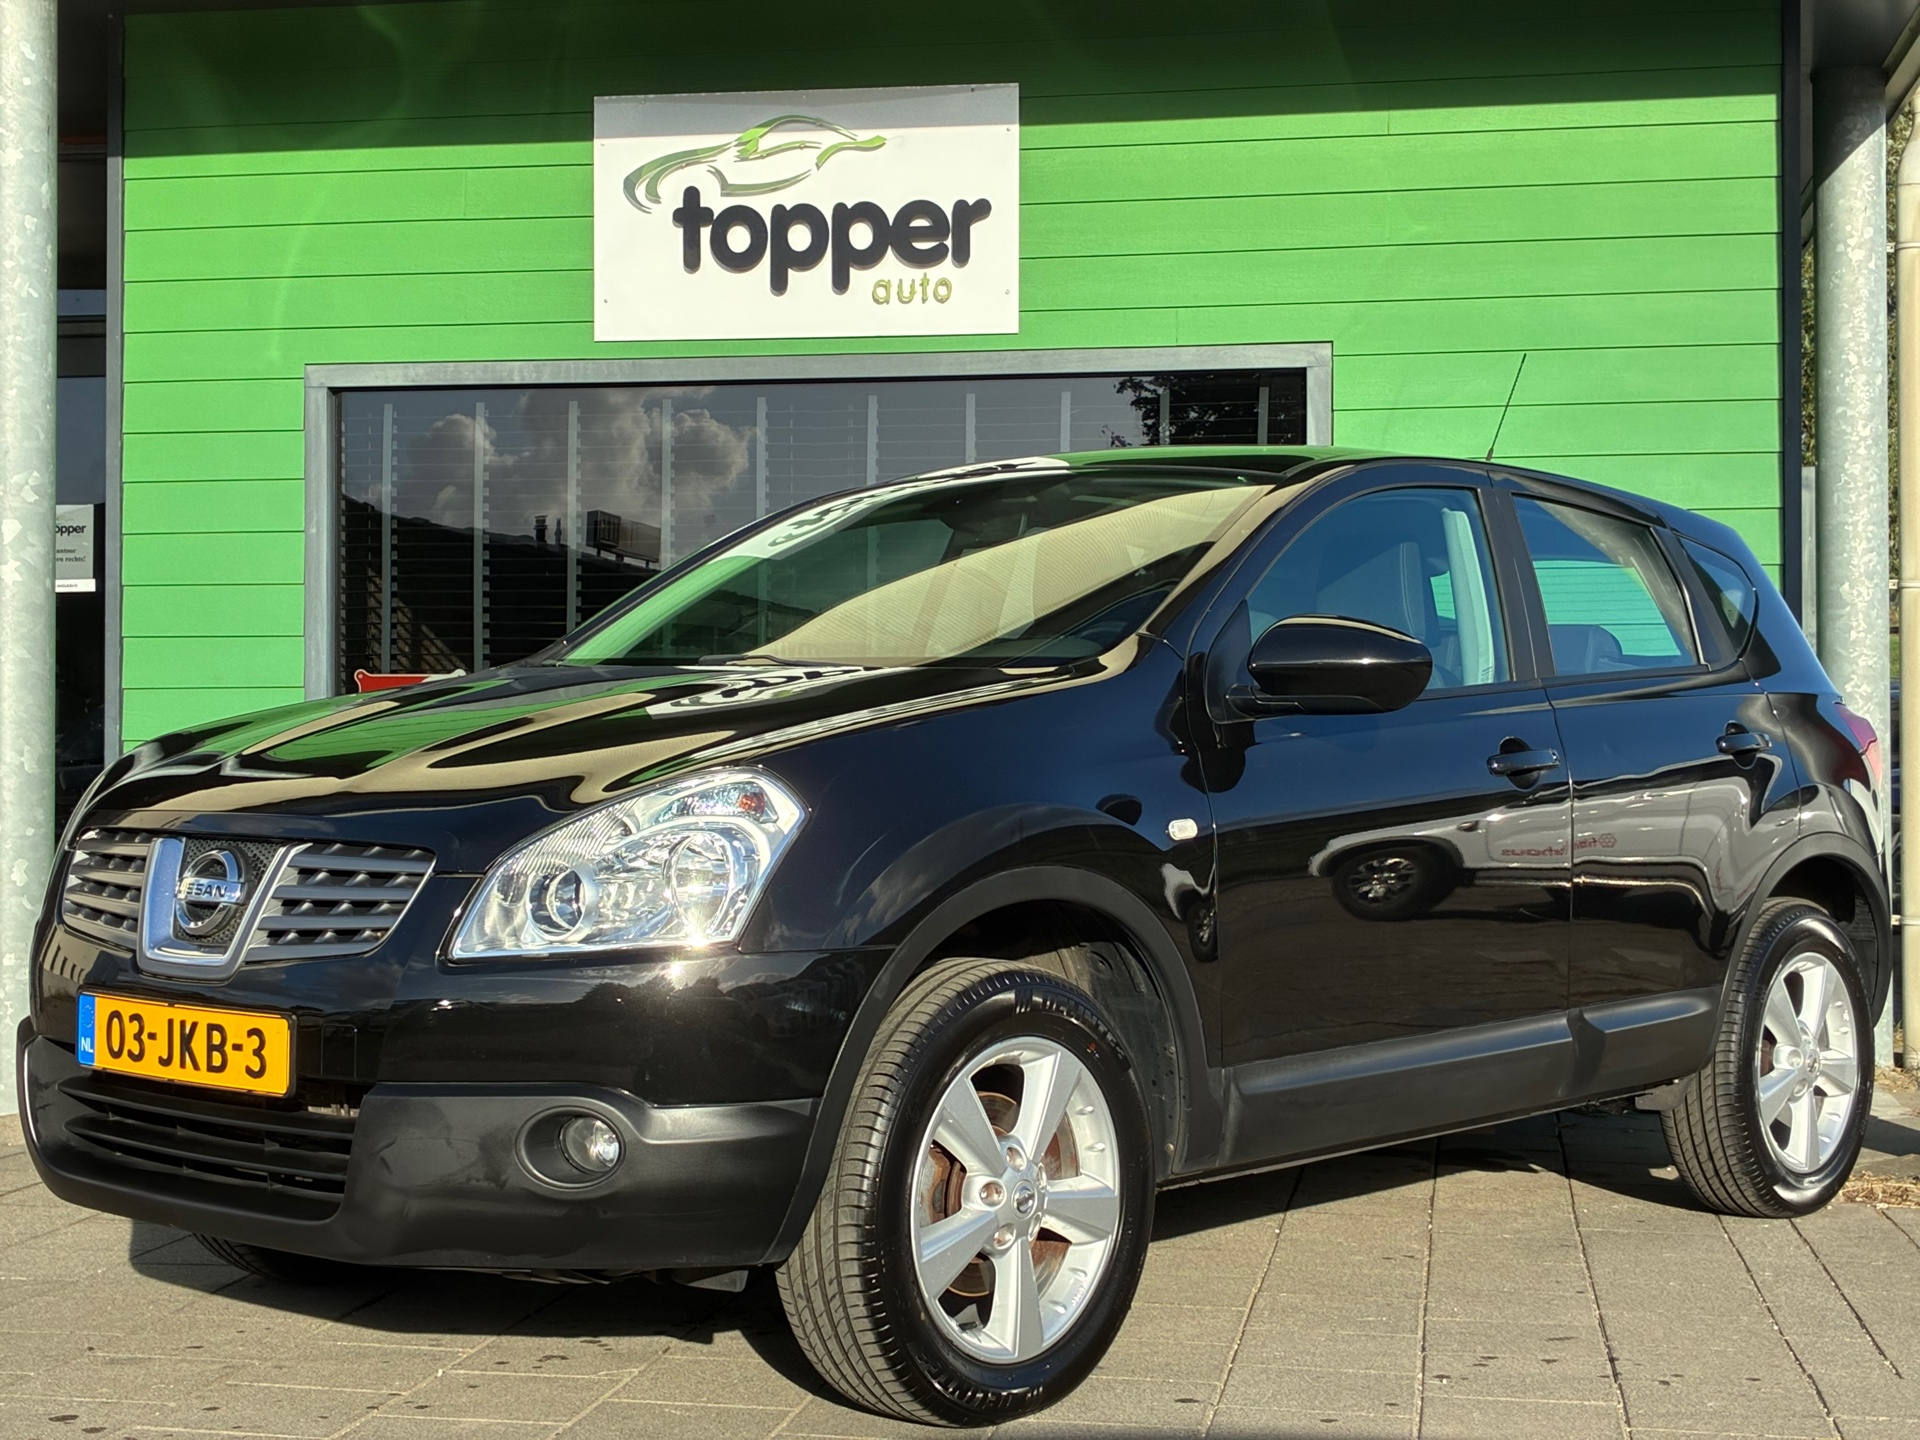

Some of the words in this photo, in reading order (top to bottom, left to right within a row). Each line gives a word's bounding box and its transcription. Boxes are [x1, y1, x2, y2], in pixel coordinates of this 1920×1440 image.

[672, 186, 992, 295] topper
[871, 273, 953, 304] auto
[56, 525, 86, 536] opper
[178, 882, 228, 898] SSAN
[80, 1036, 94, 1054] NL
[106, 1010, 267, 1079] 03-JKB-3
